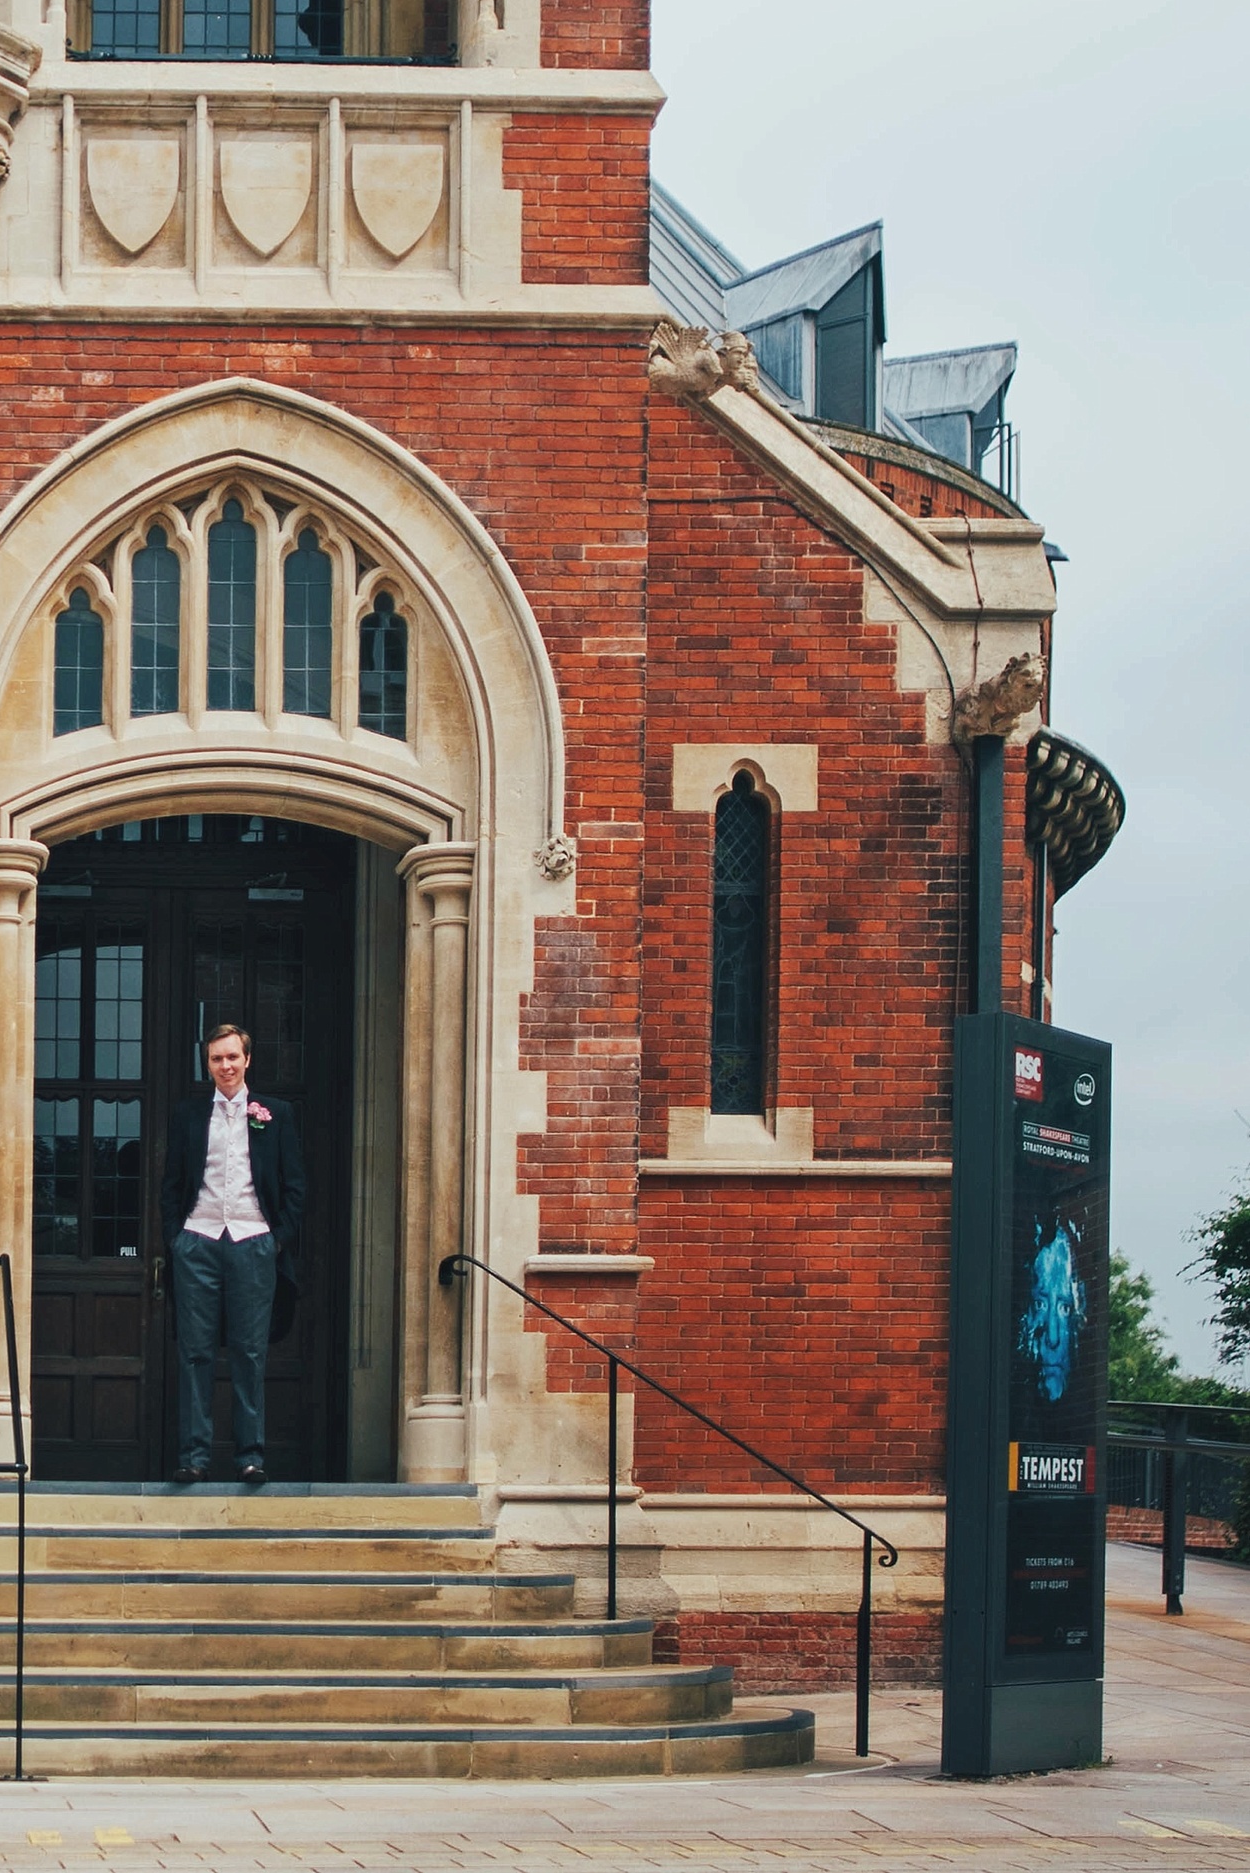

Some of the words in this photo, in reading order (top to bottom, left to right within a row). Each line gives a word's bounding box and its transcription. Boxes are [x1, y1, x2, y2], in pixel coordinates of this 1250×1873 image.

[1015, 1052, 1042, 1082] RSC
[1022, 1141, 1090, 1163] STRATFORD-UPON-AVON
[120, 1246, 137, 1256] PULL
[1022, 1456, 1084, 1482] TEMPEST
